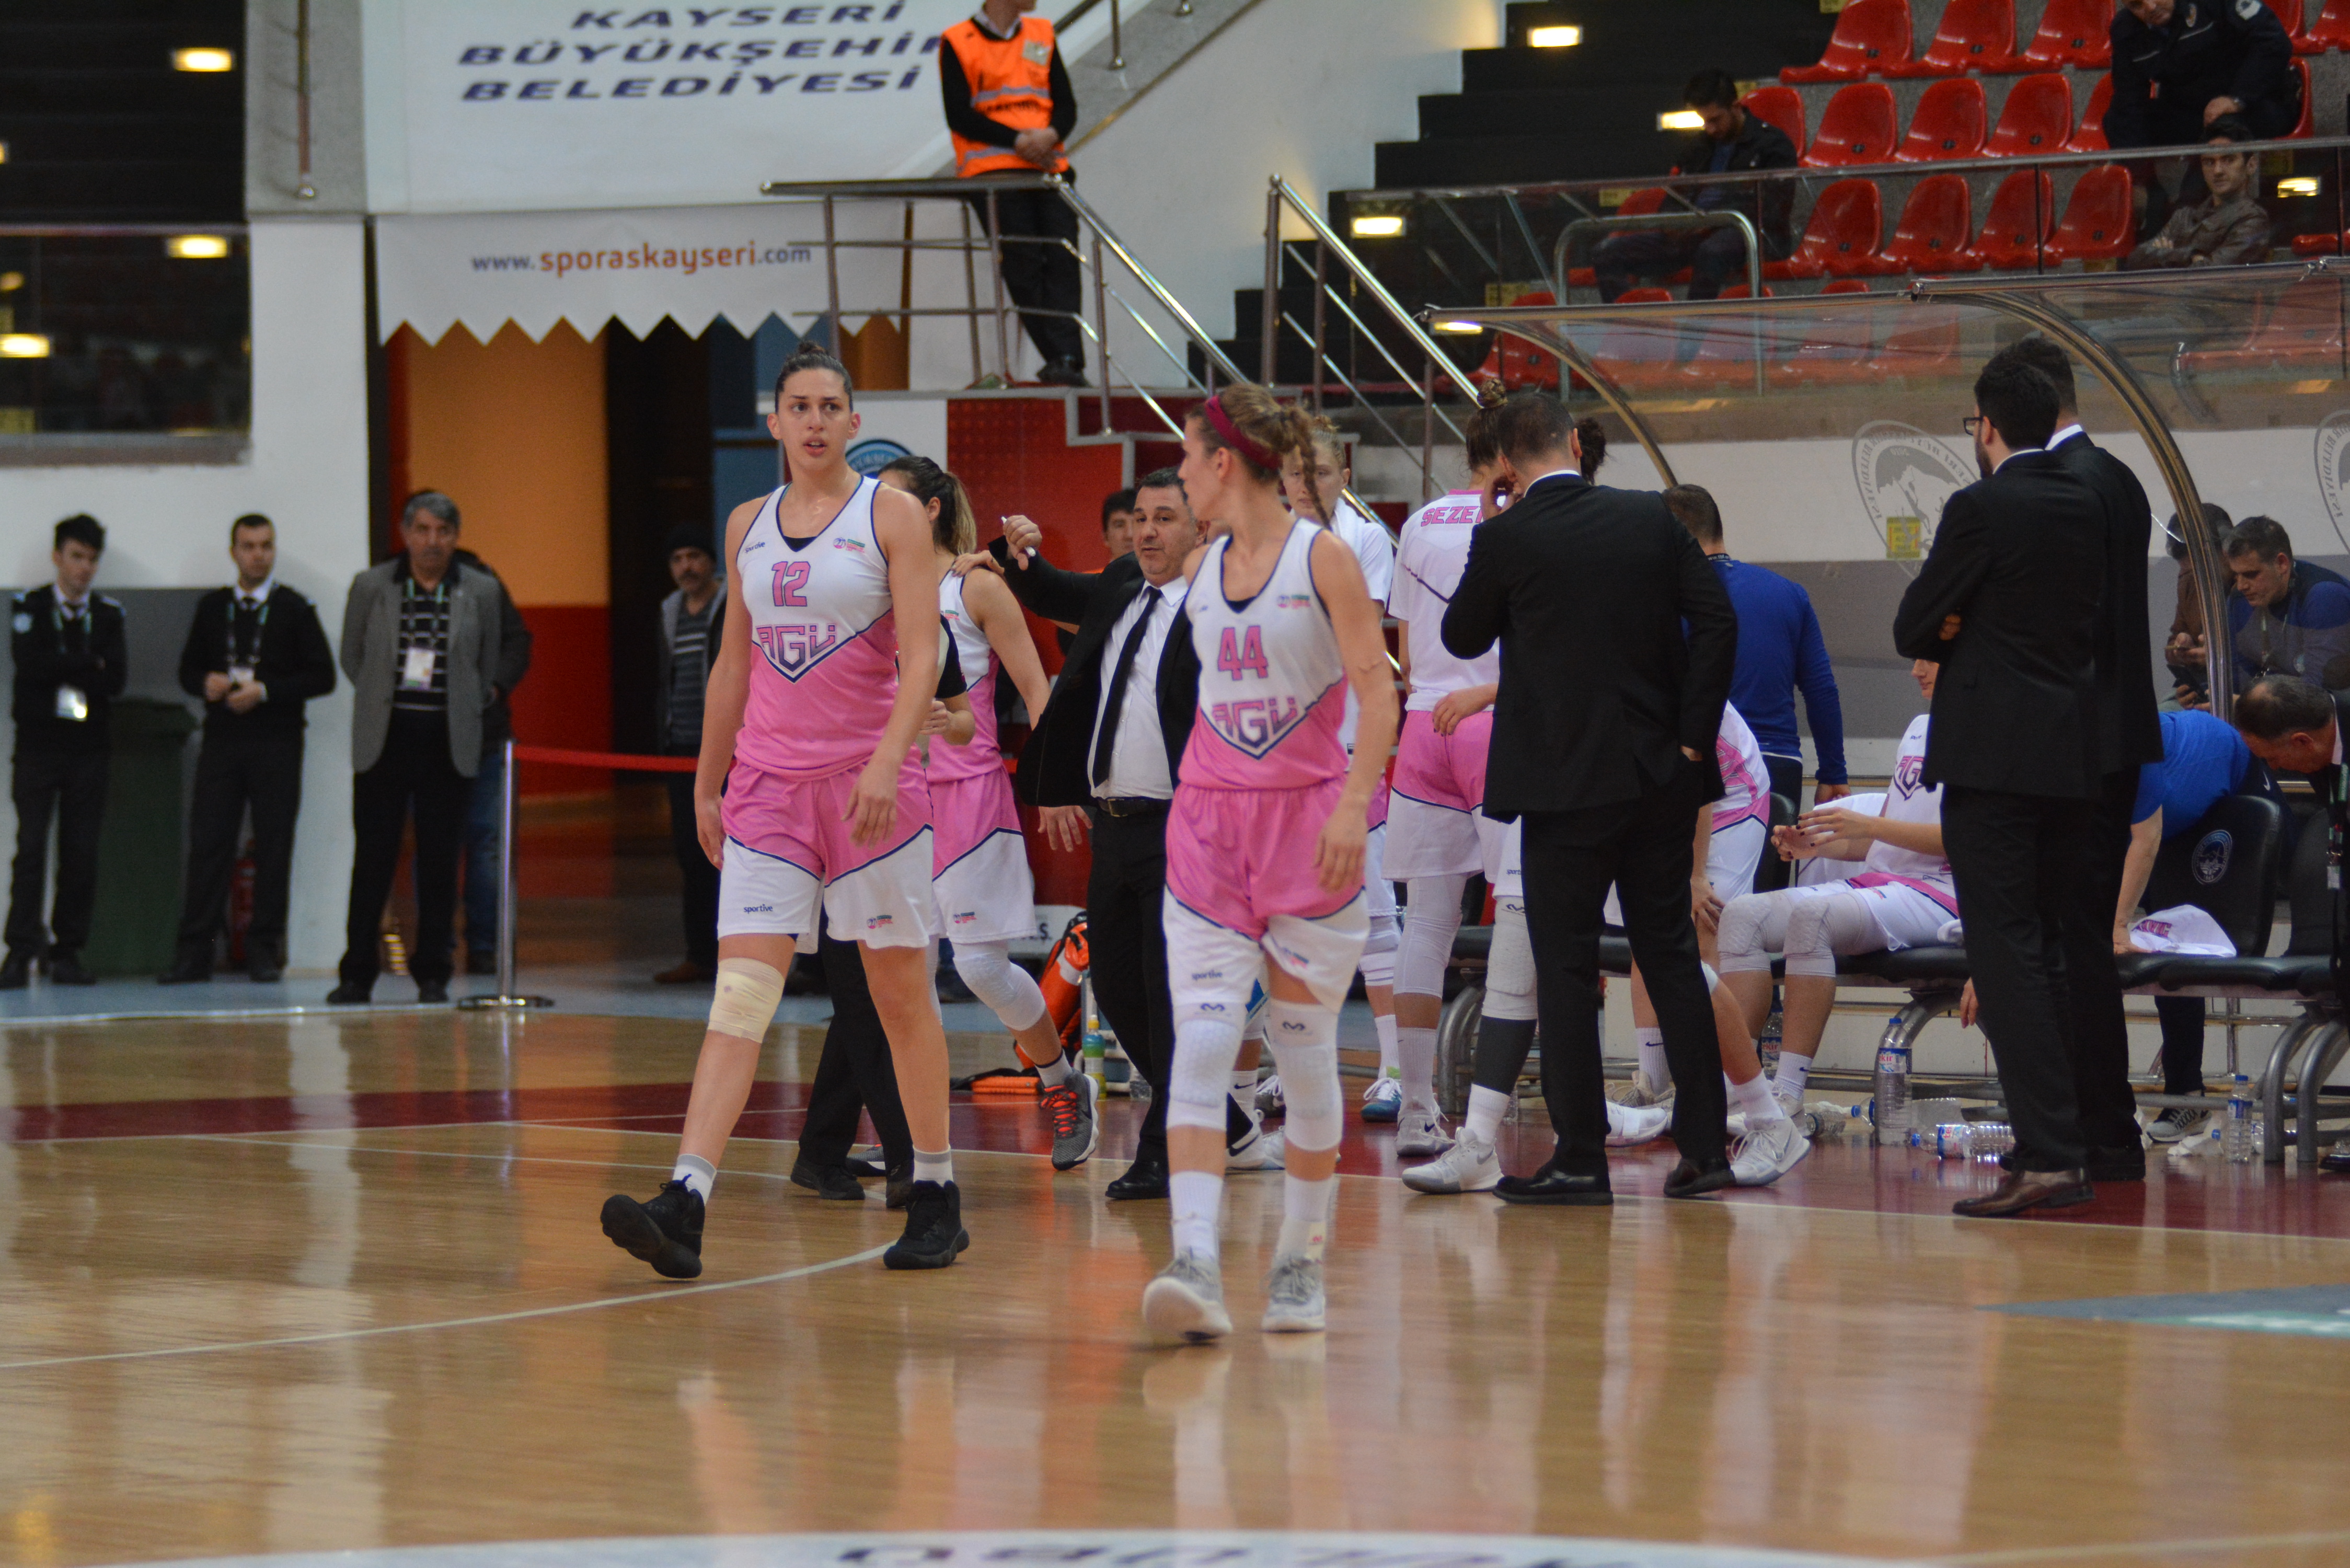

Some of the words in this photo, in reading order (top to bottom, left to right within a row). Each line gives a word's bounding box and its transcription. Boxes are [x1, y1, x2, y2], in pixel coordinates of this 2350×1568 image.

[571, 0, 905, 27] KAYSERİ
[463, 66, 921, 100] BELEDİYESİ
[771, 561, 811, 606] 12
[756, 624, 836, 673] AGÜ
[1217, 625, 1269, 681] 44
[1212, 696, 1298, 748] AGÜ
[1896, 756, 1925, 791] AG
[744, 904, 773, 914] sportive
[1192, 970, 1223, 981] sportive
